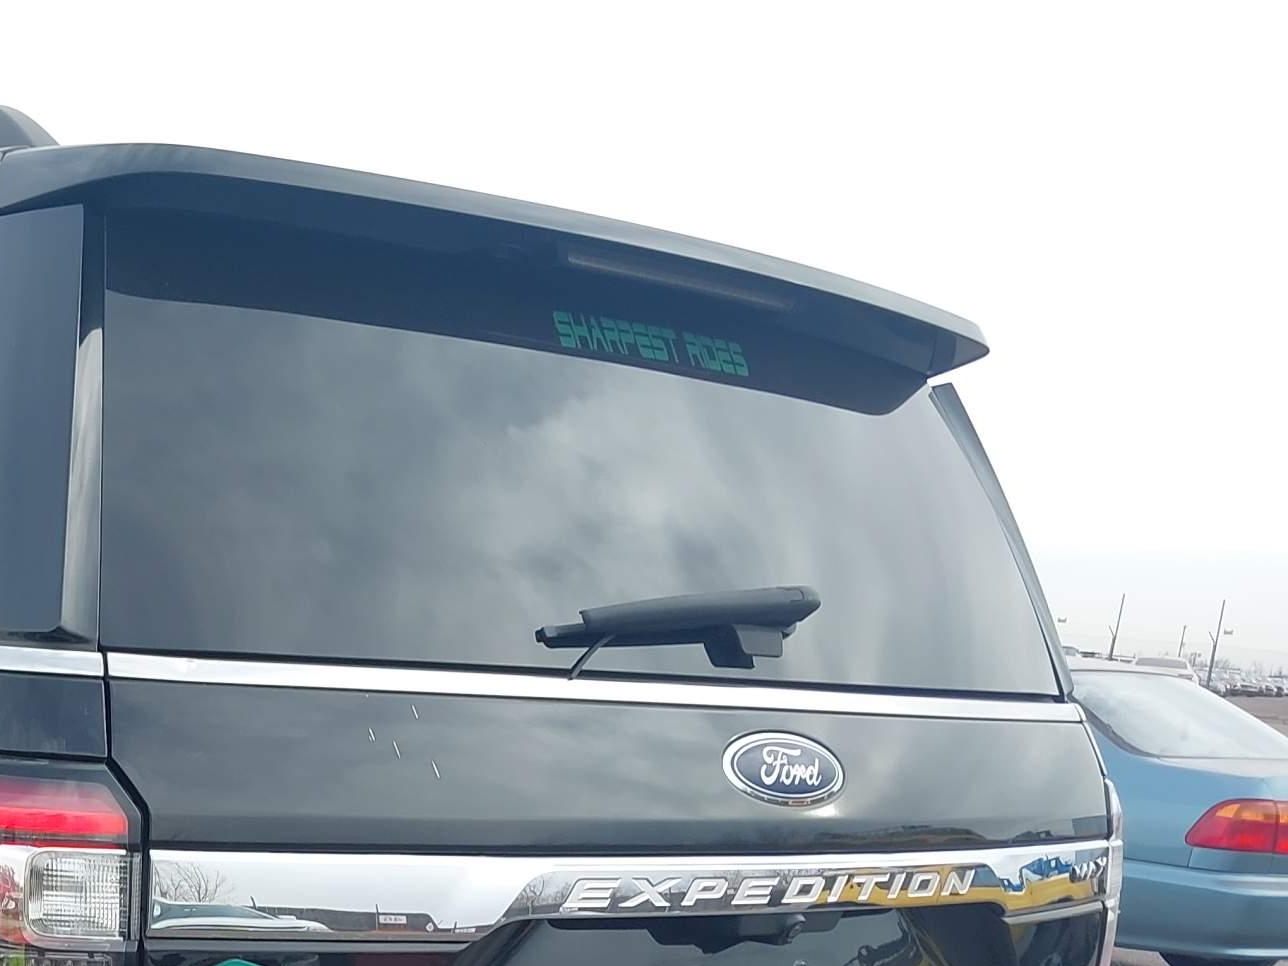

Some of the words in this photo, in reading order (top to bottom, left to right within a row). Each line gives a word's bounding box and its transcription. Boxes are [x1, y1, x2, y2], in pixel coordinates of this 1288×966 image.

[552, 309, 680, 364] SHARPEST
[682, 331, 750, 377] RIDES
[760, 746, 822, 786] Ford
[560, 868, 977, 913] EXPEDITION
